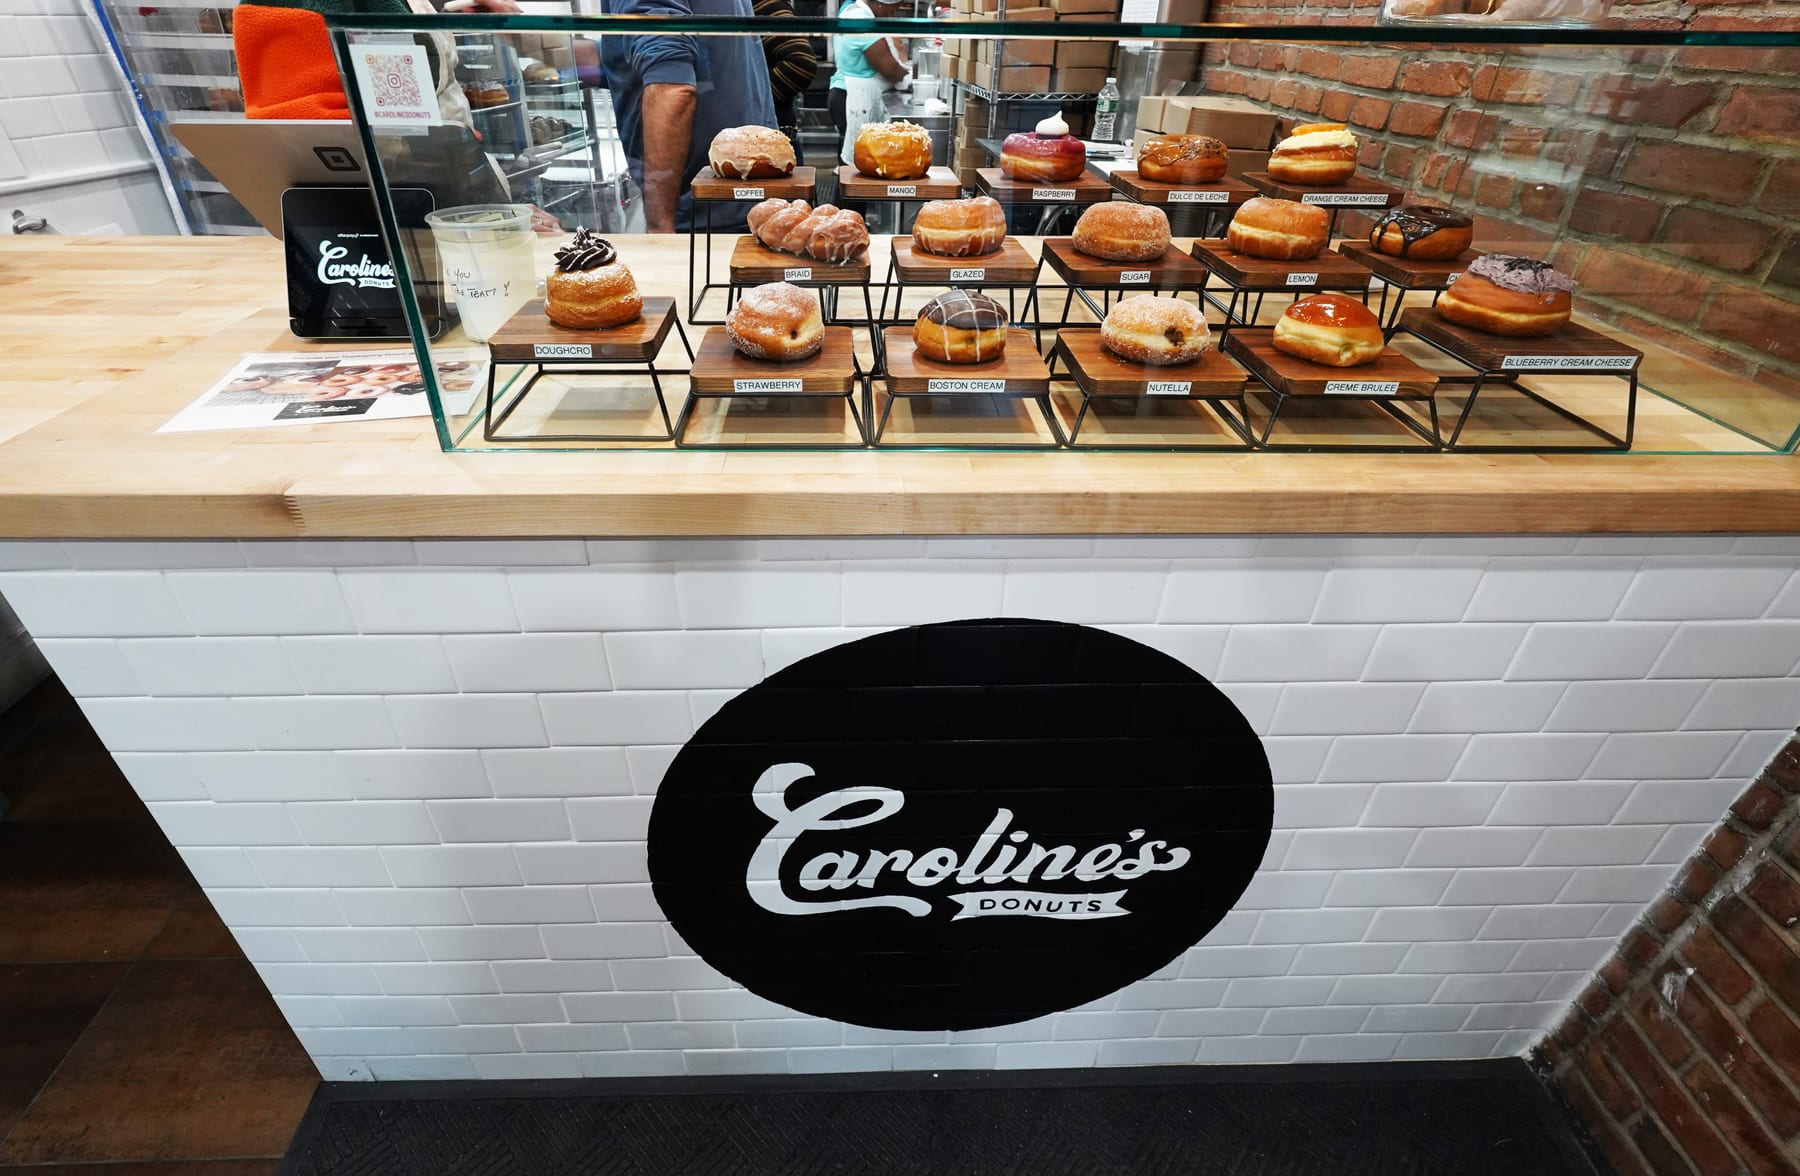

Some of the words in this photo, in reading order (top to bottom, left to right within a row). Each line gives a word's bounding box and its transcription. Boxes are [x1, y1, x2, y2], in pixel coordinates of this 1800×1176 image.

[735, 189, 764, 197] COFFEE
[1033, 190, 1076, 198] RASPBERRY
[1169, 193, 1193, 201] DULCE
[1194, 193, 1205, 201] DE
[1205, 193, 1228, 202] LECHE
[1303, 195, 1334, 203] ORANGE
[1334, 195, 1359, 203] CREAM
[785, 270, 810, 278] BRAID
[952, 270, 984, 278] GLAZED
[1121, 273, 1149, 281] SUGAR
[364, 279, 390, 287] DONUTS
[1288, 275, 1316, 283] LEMON
[535, 347, 591, 355] DOUGHCRO
[1504, 358, 1559, 367] BLUEBERRY
[1560, 358, 1593, 367] CREAM
[1593, 358, 1633, 367] CHEESE
[736, 381, 801, 390] STRAWBERRY
[929, 382, 968, 390] BOSTON
[970, 382, 1004, 390] CREAM
[1148, 384, 1190, 392] NUTELLA
[1326, 383, 1360, 392] CREME
[1360, 384, 1398, 392] BRULEE
[746, 762, 1191, 917] Caroline's
[980, 898, 1102, 912] DONUTS
